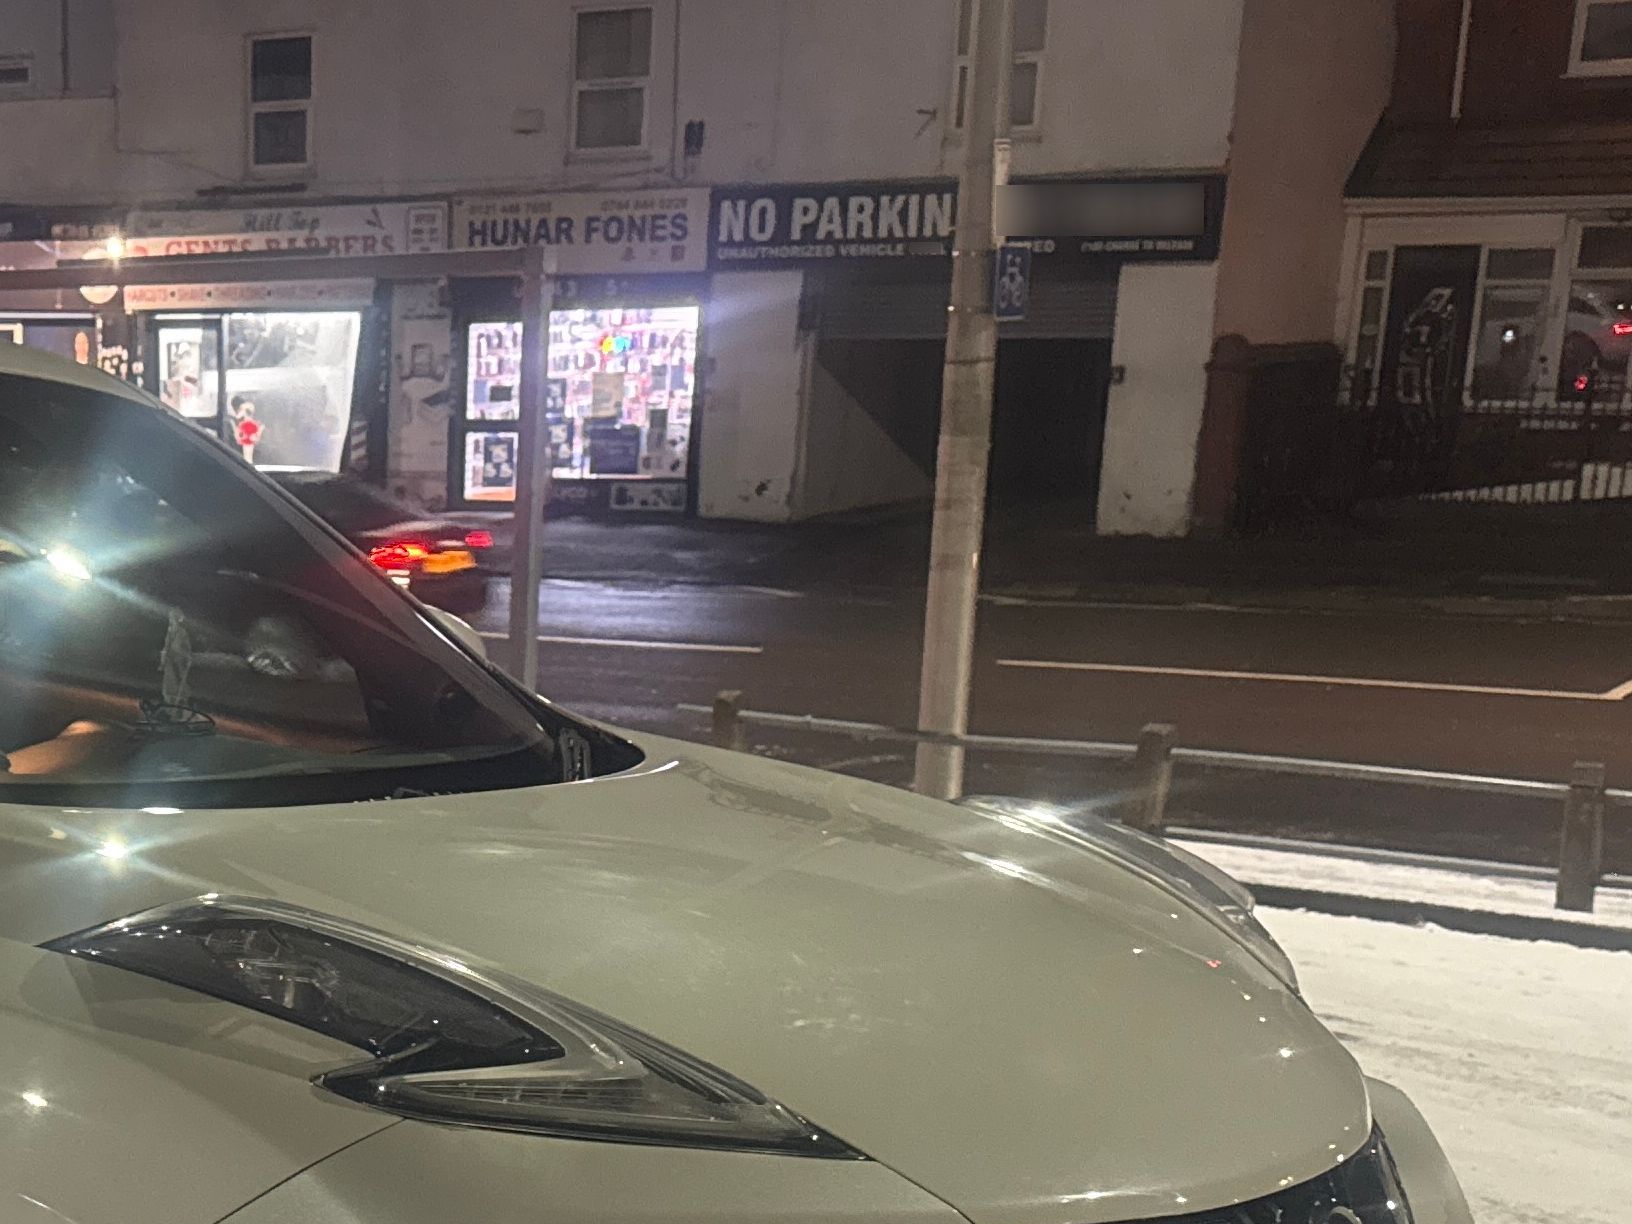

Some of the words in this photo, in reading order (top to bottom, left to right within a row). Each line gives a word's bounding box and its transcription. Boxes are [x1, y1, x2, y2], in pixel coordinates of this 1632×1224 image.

[243, 212, 281, 232] Hill
[719, 198, 776, 242] NO
[791, 193, 955, 241] PARKIN
[468, 216, 575, 248] HUNAR
[584, 212, 689, 245] FONES
[164, 238, 253, 257] GENTS
[719, 244, 835, 260] UNAUTHORIZED
[840, 243, 905, 257] VEHICLE
